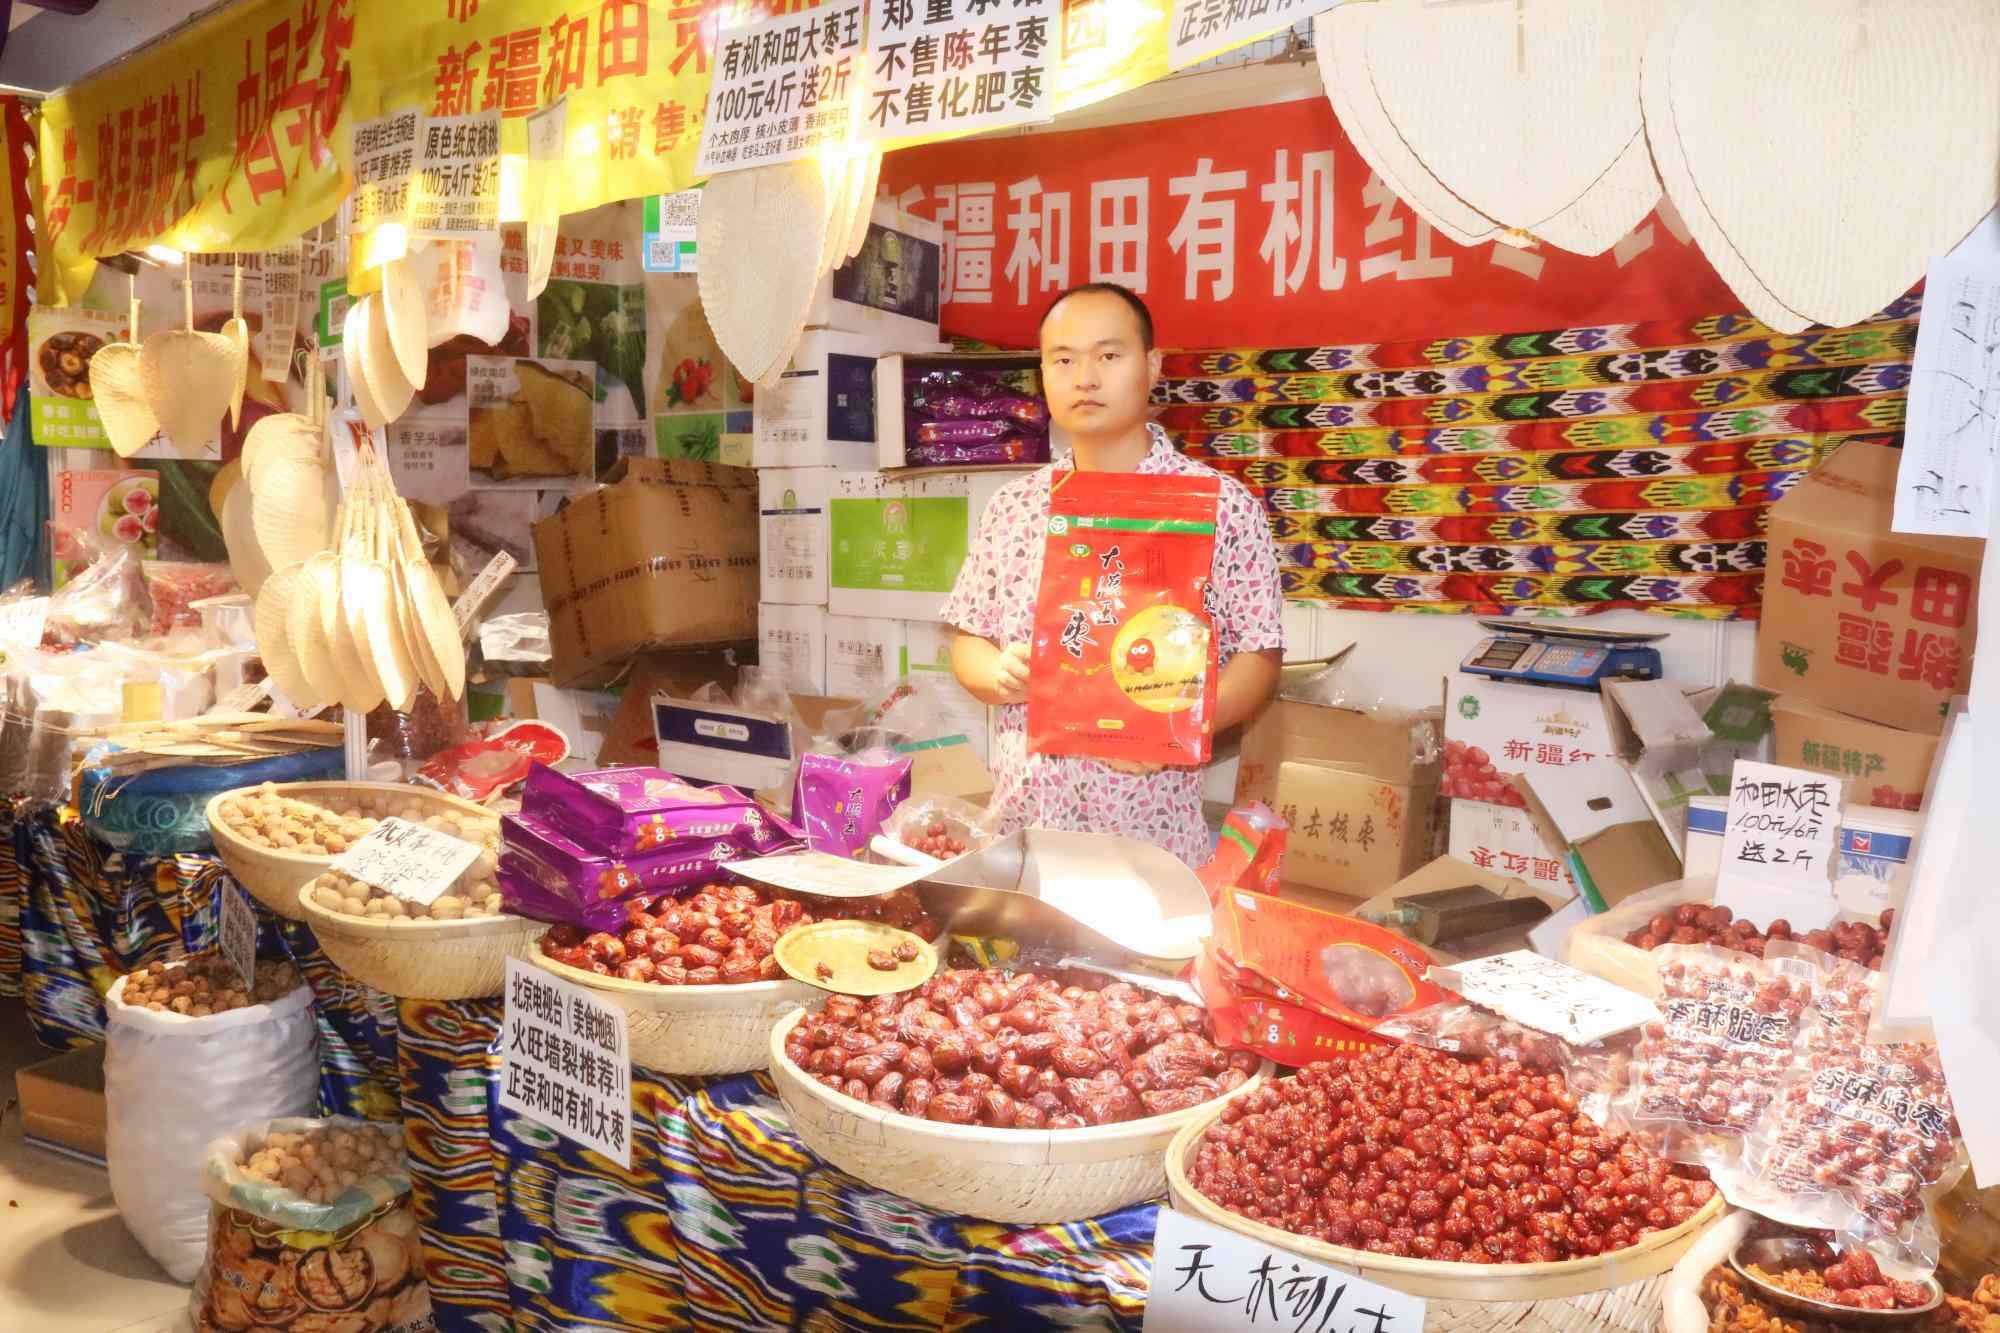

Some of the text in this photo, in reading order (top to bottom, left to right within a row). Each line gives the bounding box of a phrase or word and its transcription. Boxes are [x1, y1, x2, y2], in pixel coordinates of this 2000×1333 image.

[881, 0, 1044, 32] 郑重
[722, 5, 861, 82] 有机和田大枣王
[875, 15, 1049, 83] 不售陈年枣
[715, 55, 852, 123] 100元4斤 送2斤
[868, 66, 1045, 128] 不售化肥枣
[424, 120, 498, 160] 原色纸皮核桃
[422, 160, 498, 198] 100元4斤 送2斤
[1833, 611, 1961, 691] 新疆
[1503, 738, 1622, 767] 新疆红
[1735, 776, 1832, 826] 和田大枣
[1470, 845, 1578, 886] 疆红枣
[1736, 839, 1815, 871] 送2斤
[506, 1061, 626, 1153] 正宗和田有机大枣
